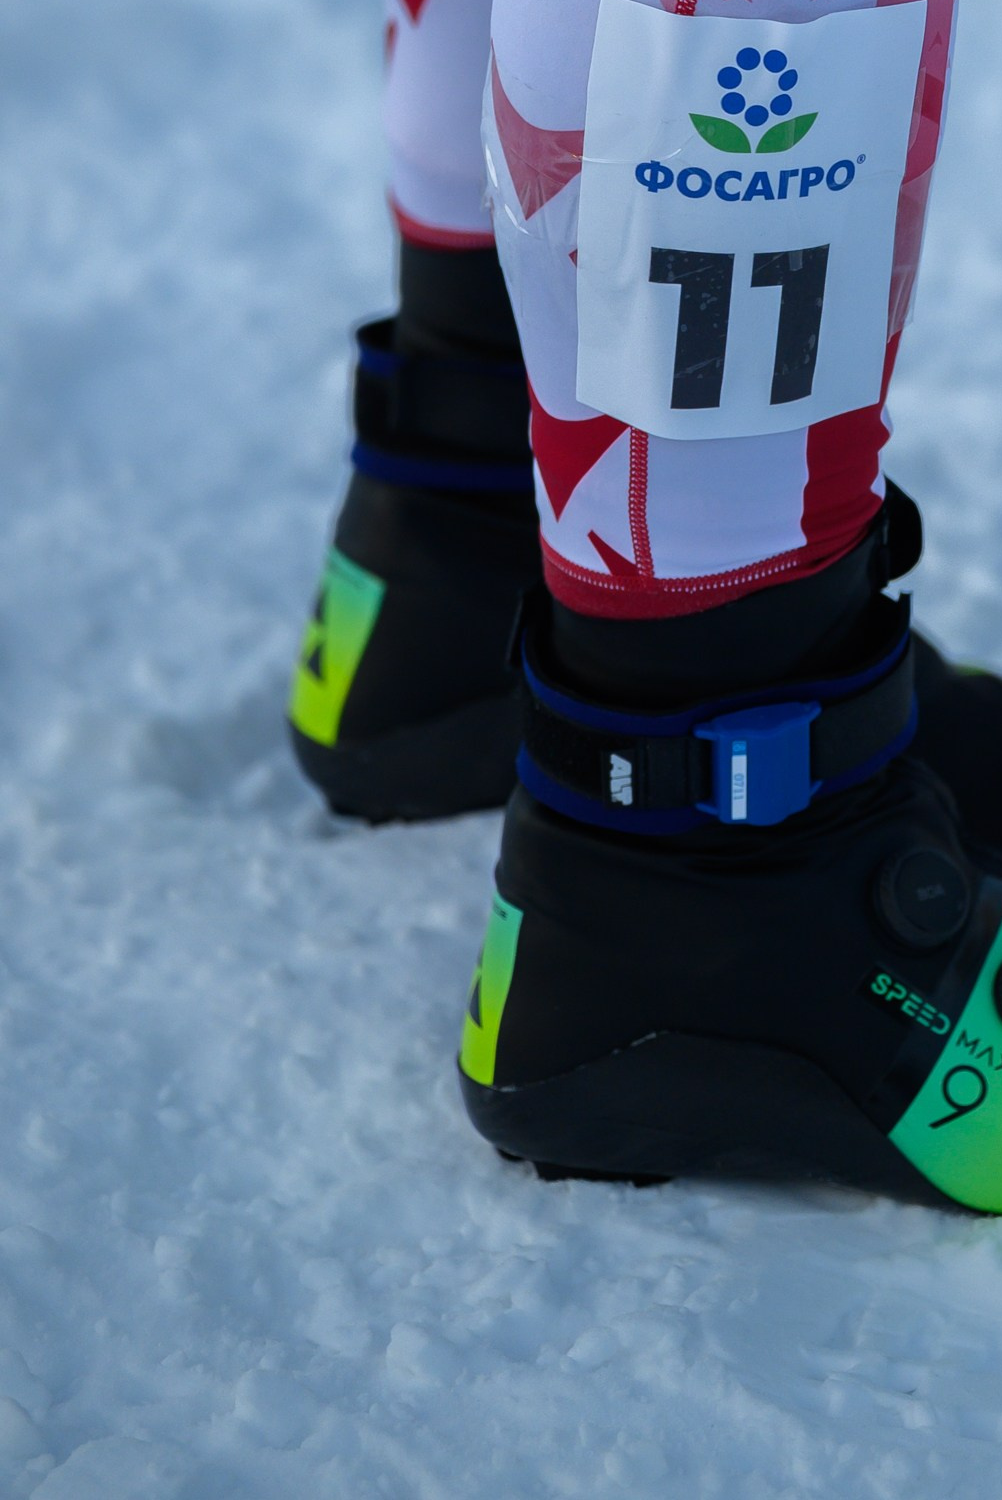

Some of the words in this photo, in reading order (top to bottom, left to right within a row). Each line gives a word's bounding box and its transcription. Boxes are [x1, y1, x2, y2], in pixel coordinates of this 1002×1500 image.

[648, 243, 831, 410] 11
[870, 972, 951, 1036] SPEED
[928, 1064, 988, 1130] 9
